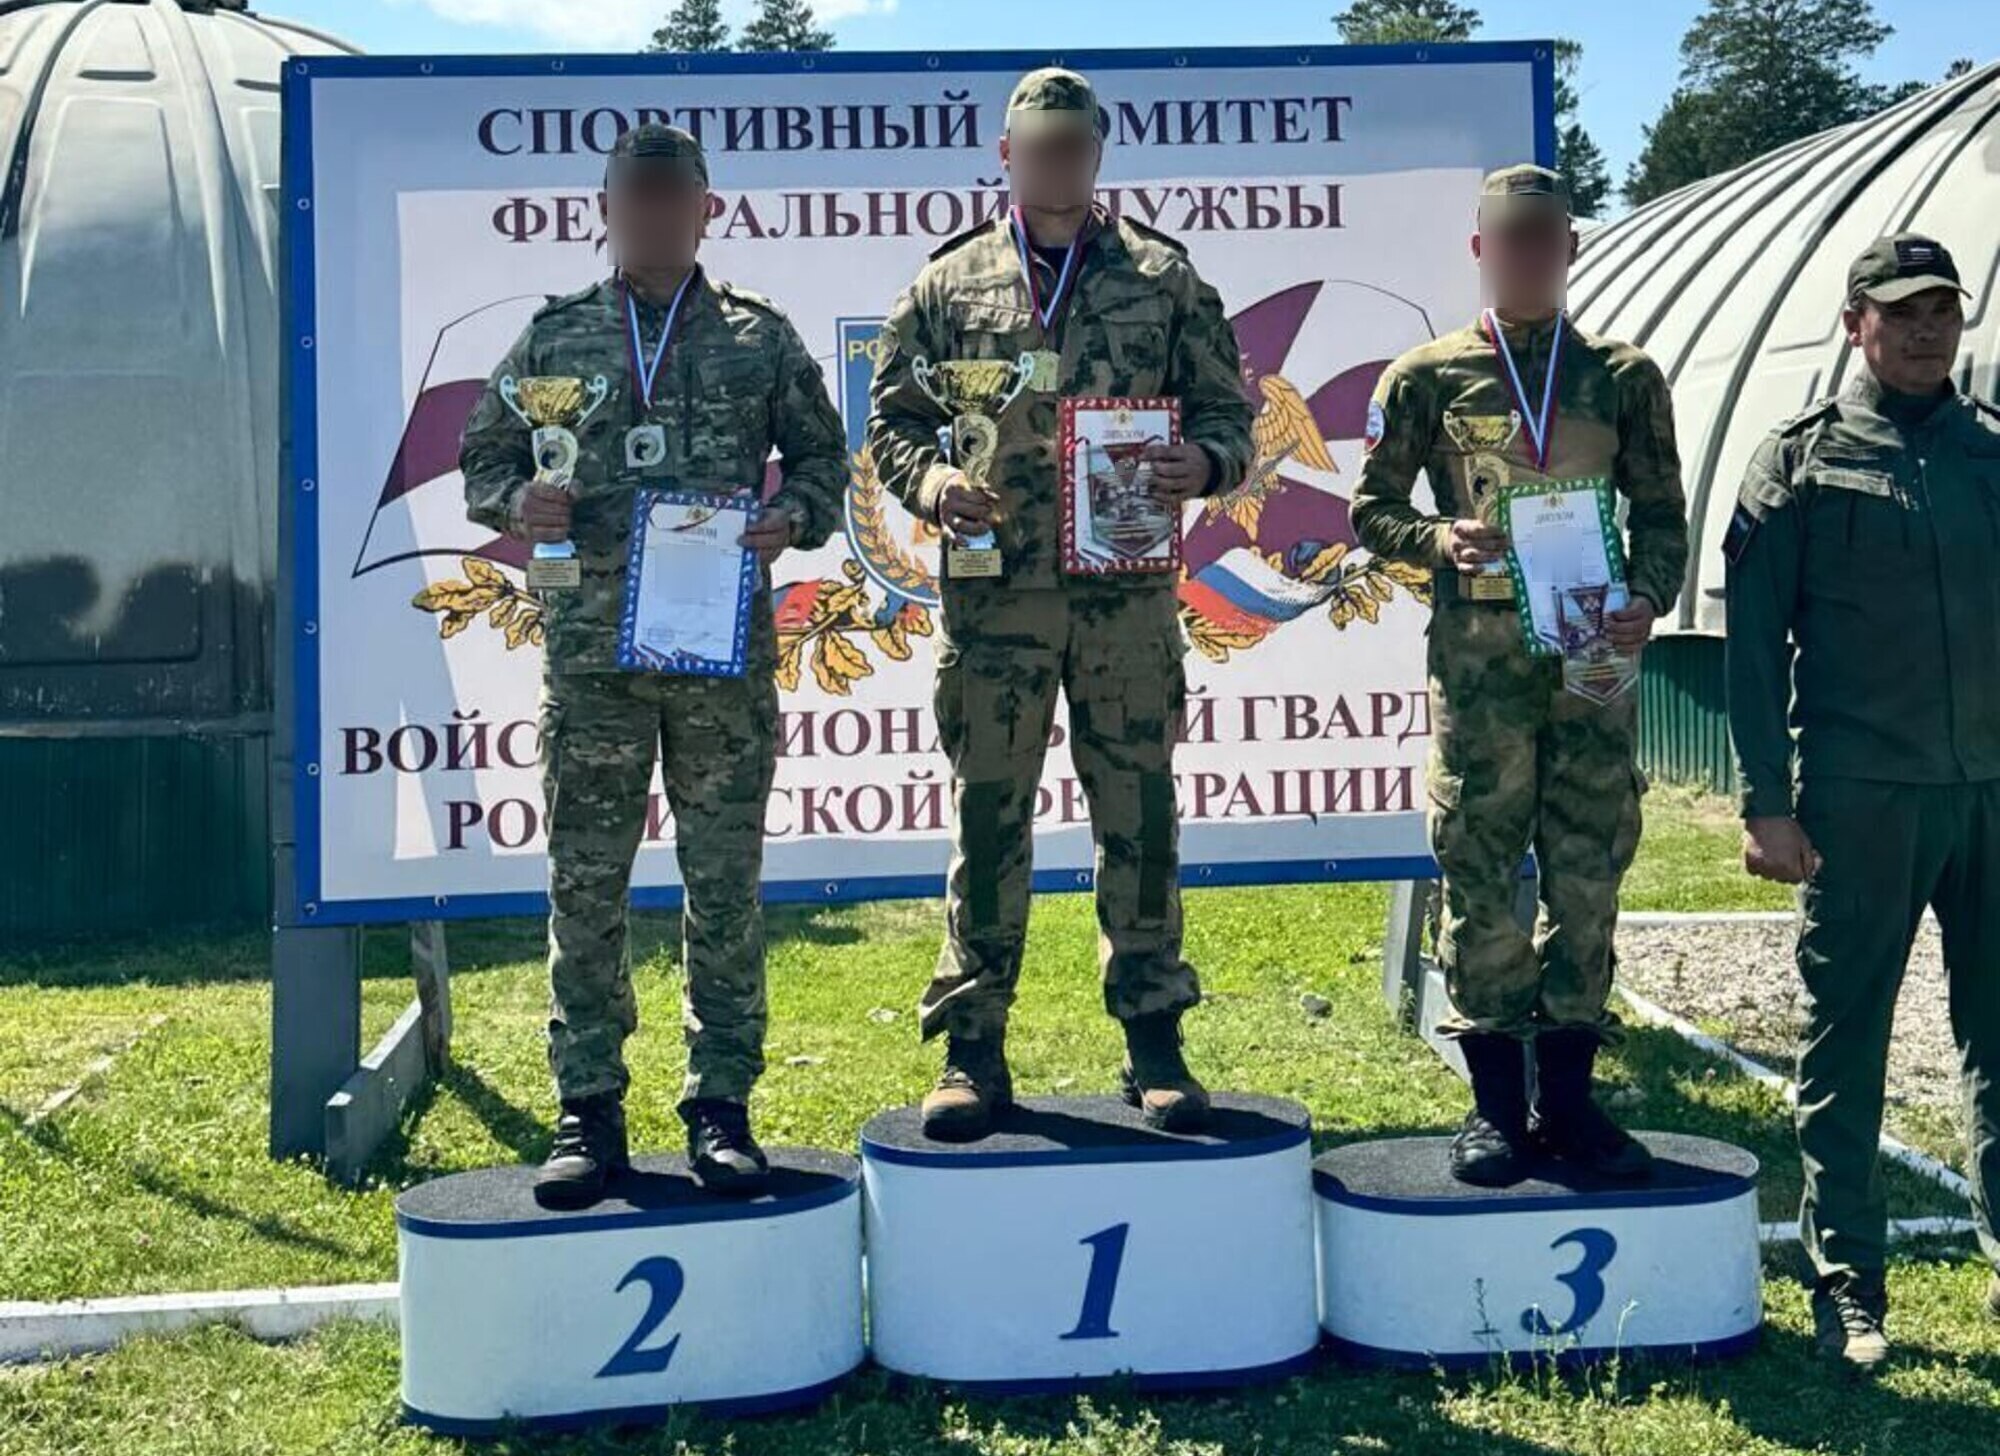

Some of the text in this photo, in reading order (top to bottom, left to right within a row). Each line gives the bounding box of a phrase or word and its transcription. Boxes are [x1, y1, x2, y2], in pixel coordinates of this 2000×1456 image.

[1098, 96, 1353, 146] МИТЕТ
[492, 177, 1346, 254] ФЕАЛЬНОЙ ЛУЖБЫ
[338, 709, 537, 775] ВОЙС
[1237, 691, 1432, 749] ГВАРД
[1033, 765, 1416, 827] ЕРАЦИИ
[593, 1256, 685, 1378] 2
[1059, 1223, 1130, 1340] 1
[1520, 1227, 1618, 1335] 3
